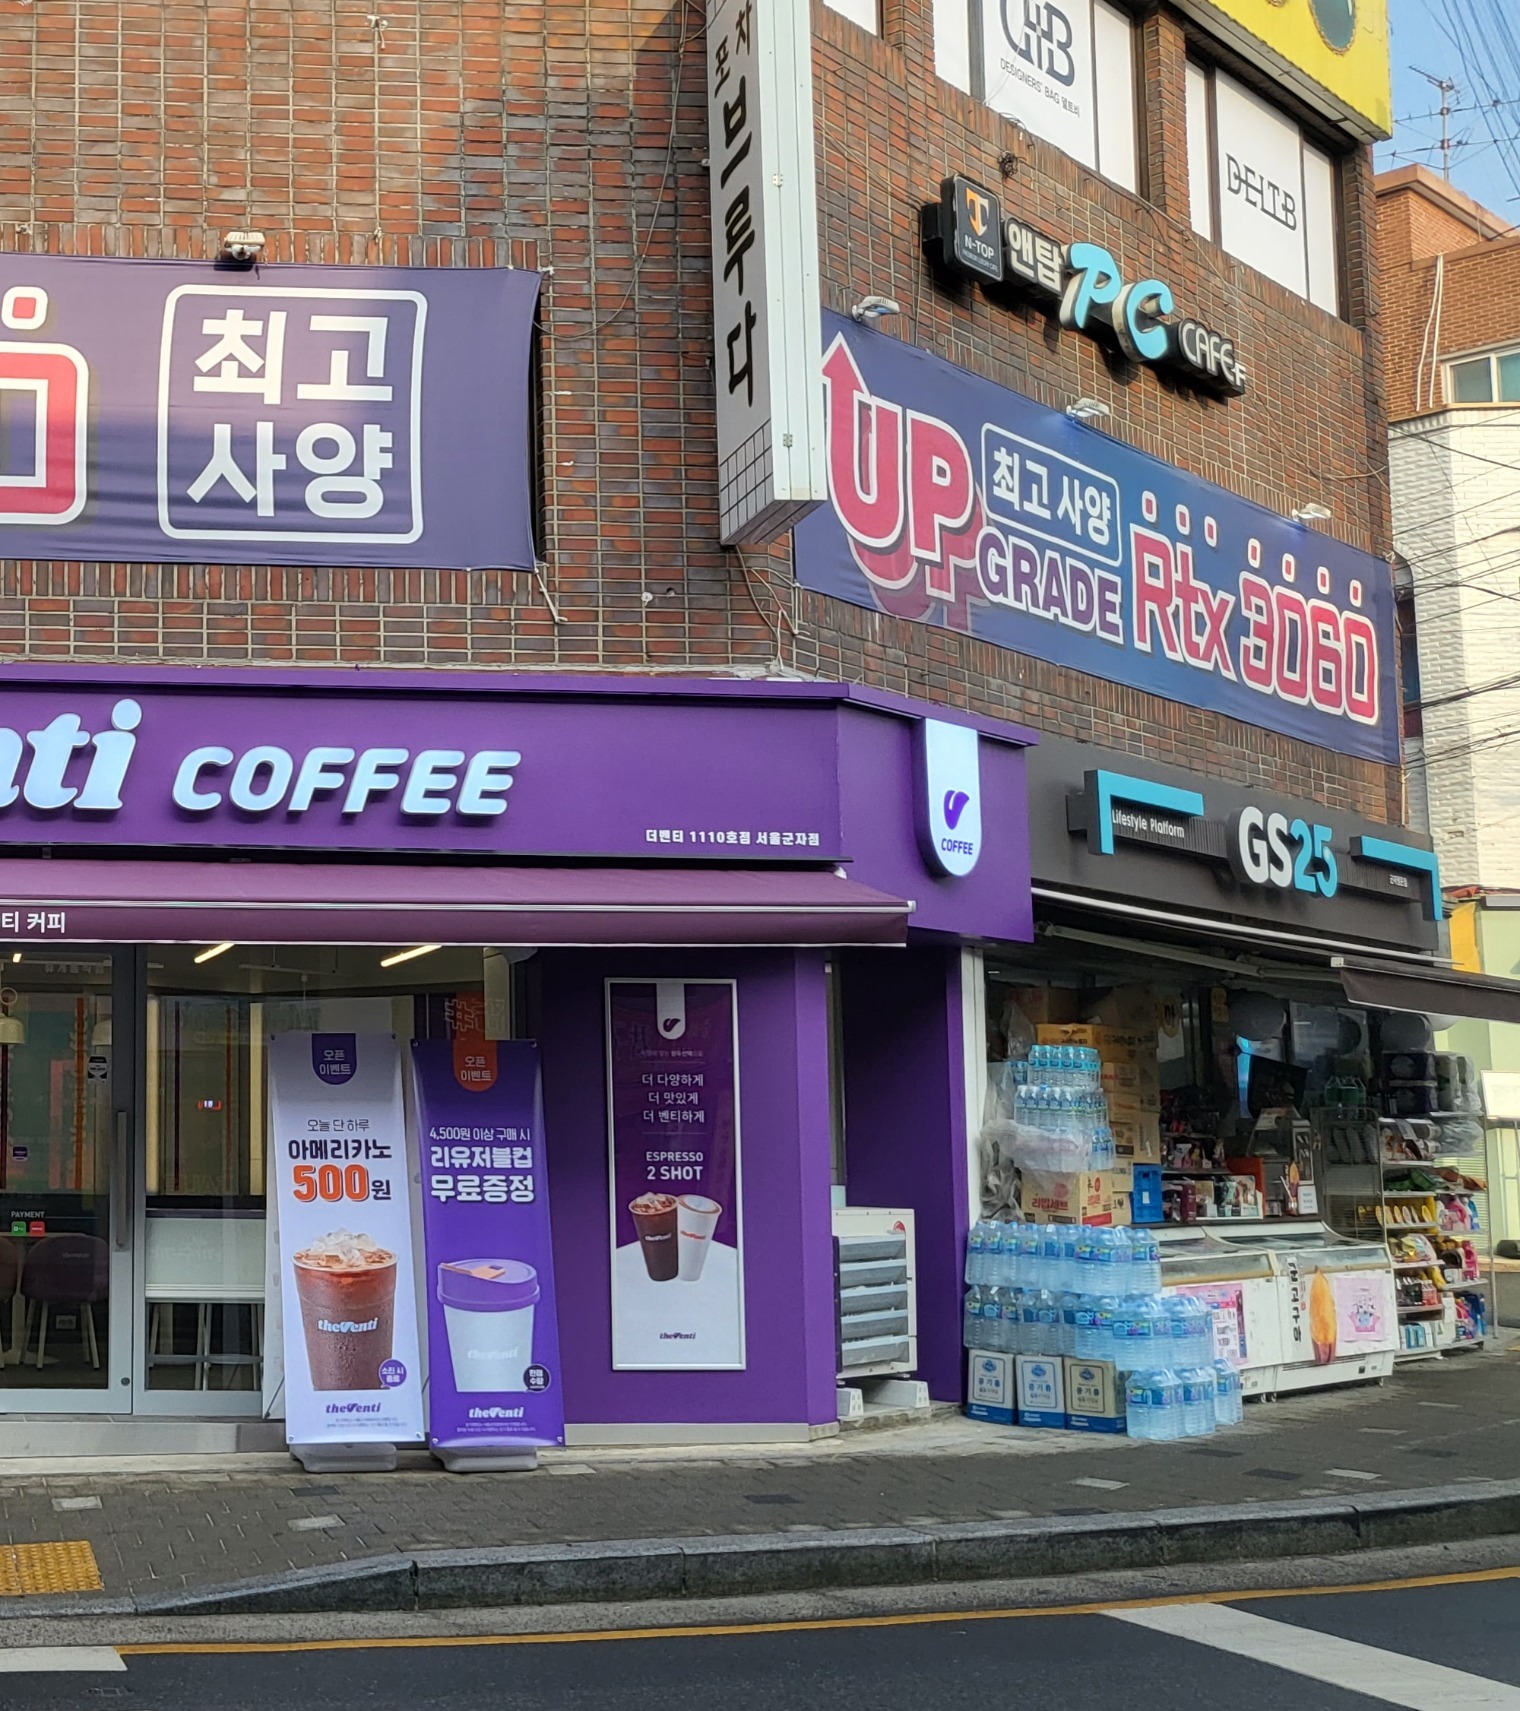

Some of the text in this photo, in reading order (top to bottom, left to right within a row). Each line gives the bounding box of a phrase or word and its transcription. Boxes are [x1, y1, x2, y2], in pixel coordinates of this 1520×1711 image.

[1044, 86, 1060, 105] BAG
[964, 234, 995, 260] N-TOP
[1008, 222, 1064, 292] 앤탑
[1068, 242, 1174, 361] PC
[1182, 321, 1235, 383] CAFE
[193, 308, 394, 405] 최고
[824, 340, 974, 562] UP
[186, 421, 394, 519] 사양
[992, 445, 1112, 546] 최고 사양
[976, 525, 1124, 645] GRADE
[1130, 522, 1379, 726] Rtx 3060
[171, 744, 522, 817] COFFEE
[1111, 809, 1185, 839] Lifestyle Platform
[645, 829, 821, 847] 더벤티 1110호점 서울군자점
[940, 837, 974, 857] COFFEE
[1238, 805, 1338, 898] GS25
[26, 911, 67, 934] 커피
[323, 1048, 346, 1062] 오픈
[464, 1055, 486, 1069] 오픈
[319, 1063, 352, 1076] 이벤트
[460, 1069, 493, 1082] 이벤트
[641, 1073, 705, 1087] 더 다양하게
[648, 1091, 699, 1105] 더 맛있게
[307, 1118, 371, 1132] 오늘 단 하루
[643, 1109, 706, 1123] 더 벤티하게
[429, 1126, 531, 1142] 4,500원 이상 구매 시
[288, 1138, 393, 1161] 아메리카노
[430, 1145, 534, 1170] 리유저블컵
[645, 1151, 704, 1163] ESPRESSO
[291, 1163, 392, 1203] 500원
[646, 1165, 704, 1181] 2 SHOT
[430, 1173, 535, 1204] 무료증정
[10, 1210, 45, 1219] PAYMENT
